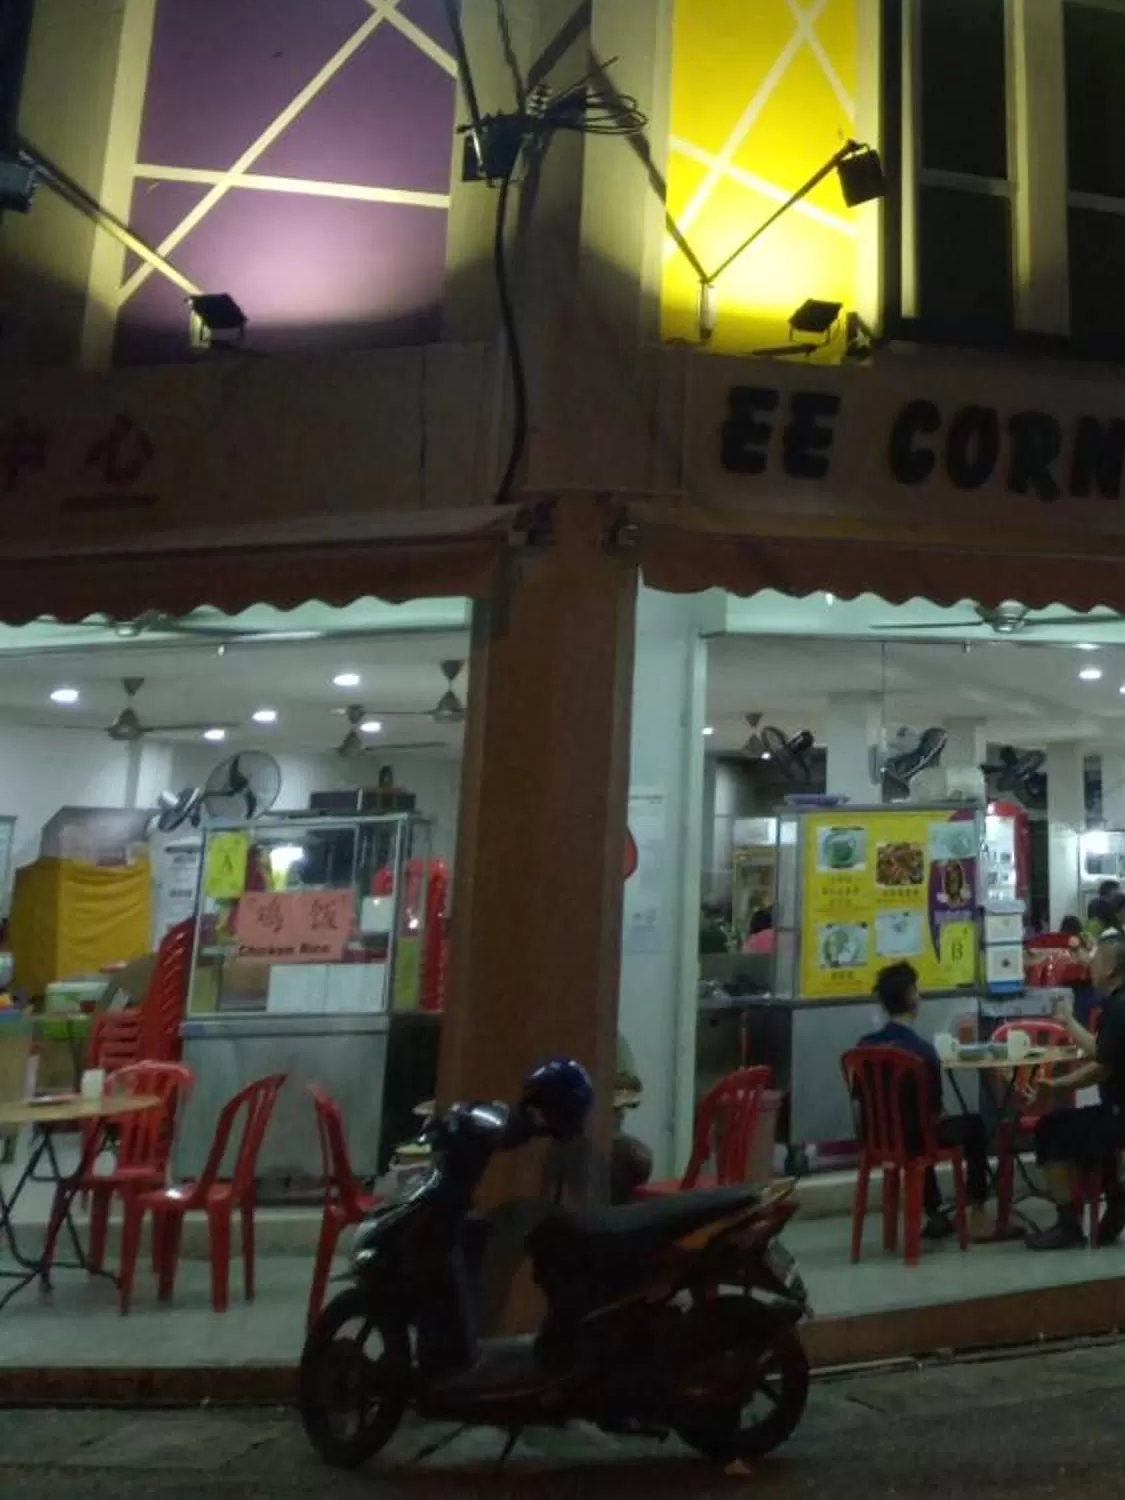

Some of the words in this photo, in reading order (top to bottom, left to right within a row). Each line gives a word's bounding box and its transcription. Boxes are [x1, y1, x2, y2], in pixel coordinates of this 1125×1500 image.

[720, 386, 841, 480] EE
[239, 944, 294, 957] Chicken
[300, 942, 331, 955] Rice
